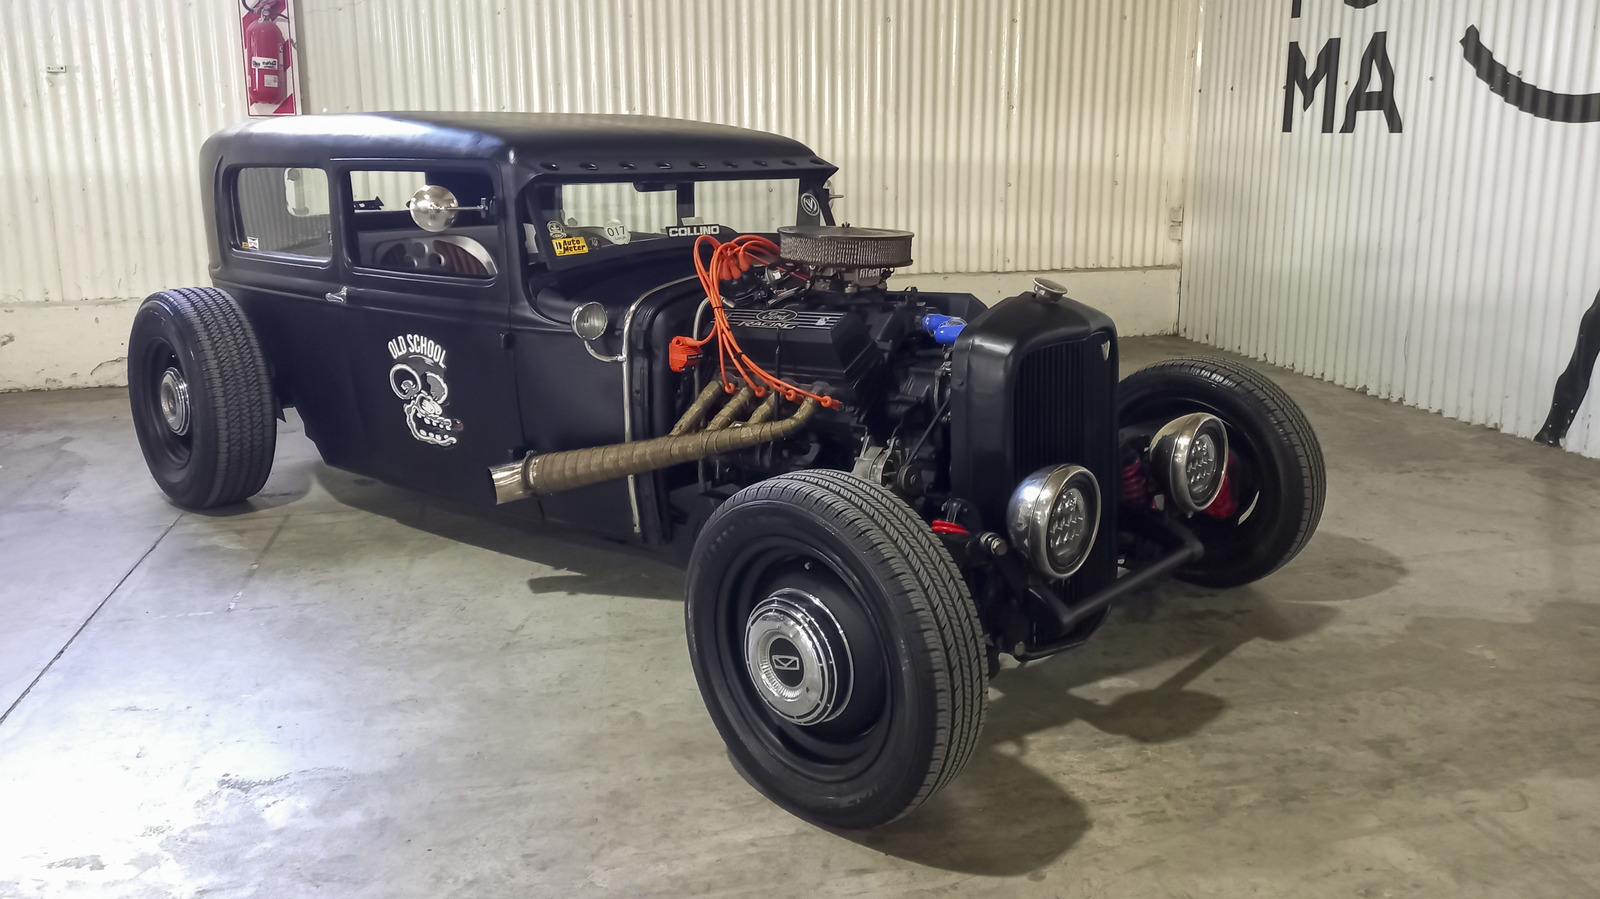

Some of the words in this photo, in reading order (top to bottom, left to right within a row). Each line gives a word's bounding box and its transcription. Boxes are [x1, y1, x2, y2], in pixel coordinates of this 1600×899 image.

[1281, 31, 1403, 133] MA
[607, 225, 625, 237] 017
[669, 225, 720, 237] COLLINO
[563, 245, 586, 253] Meter
[762, 310, 791, 320] Ford
[738, 320, 796, 329] RACING
[387, 335, 407, 360] OLD
[406, 334, 447, 368] SCHOOL
